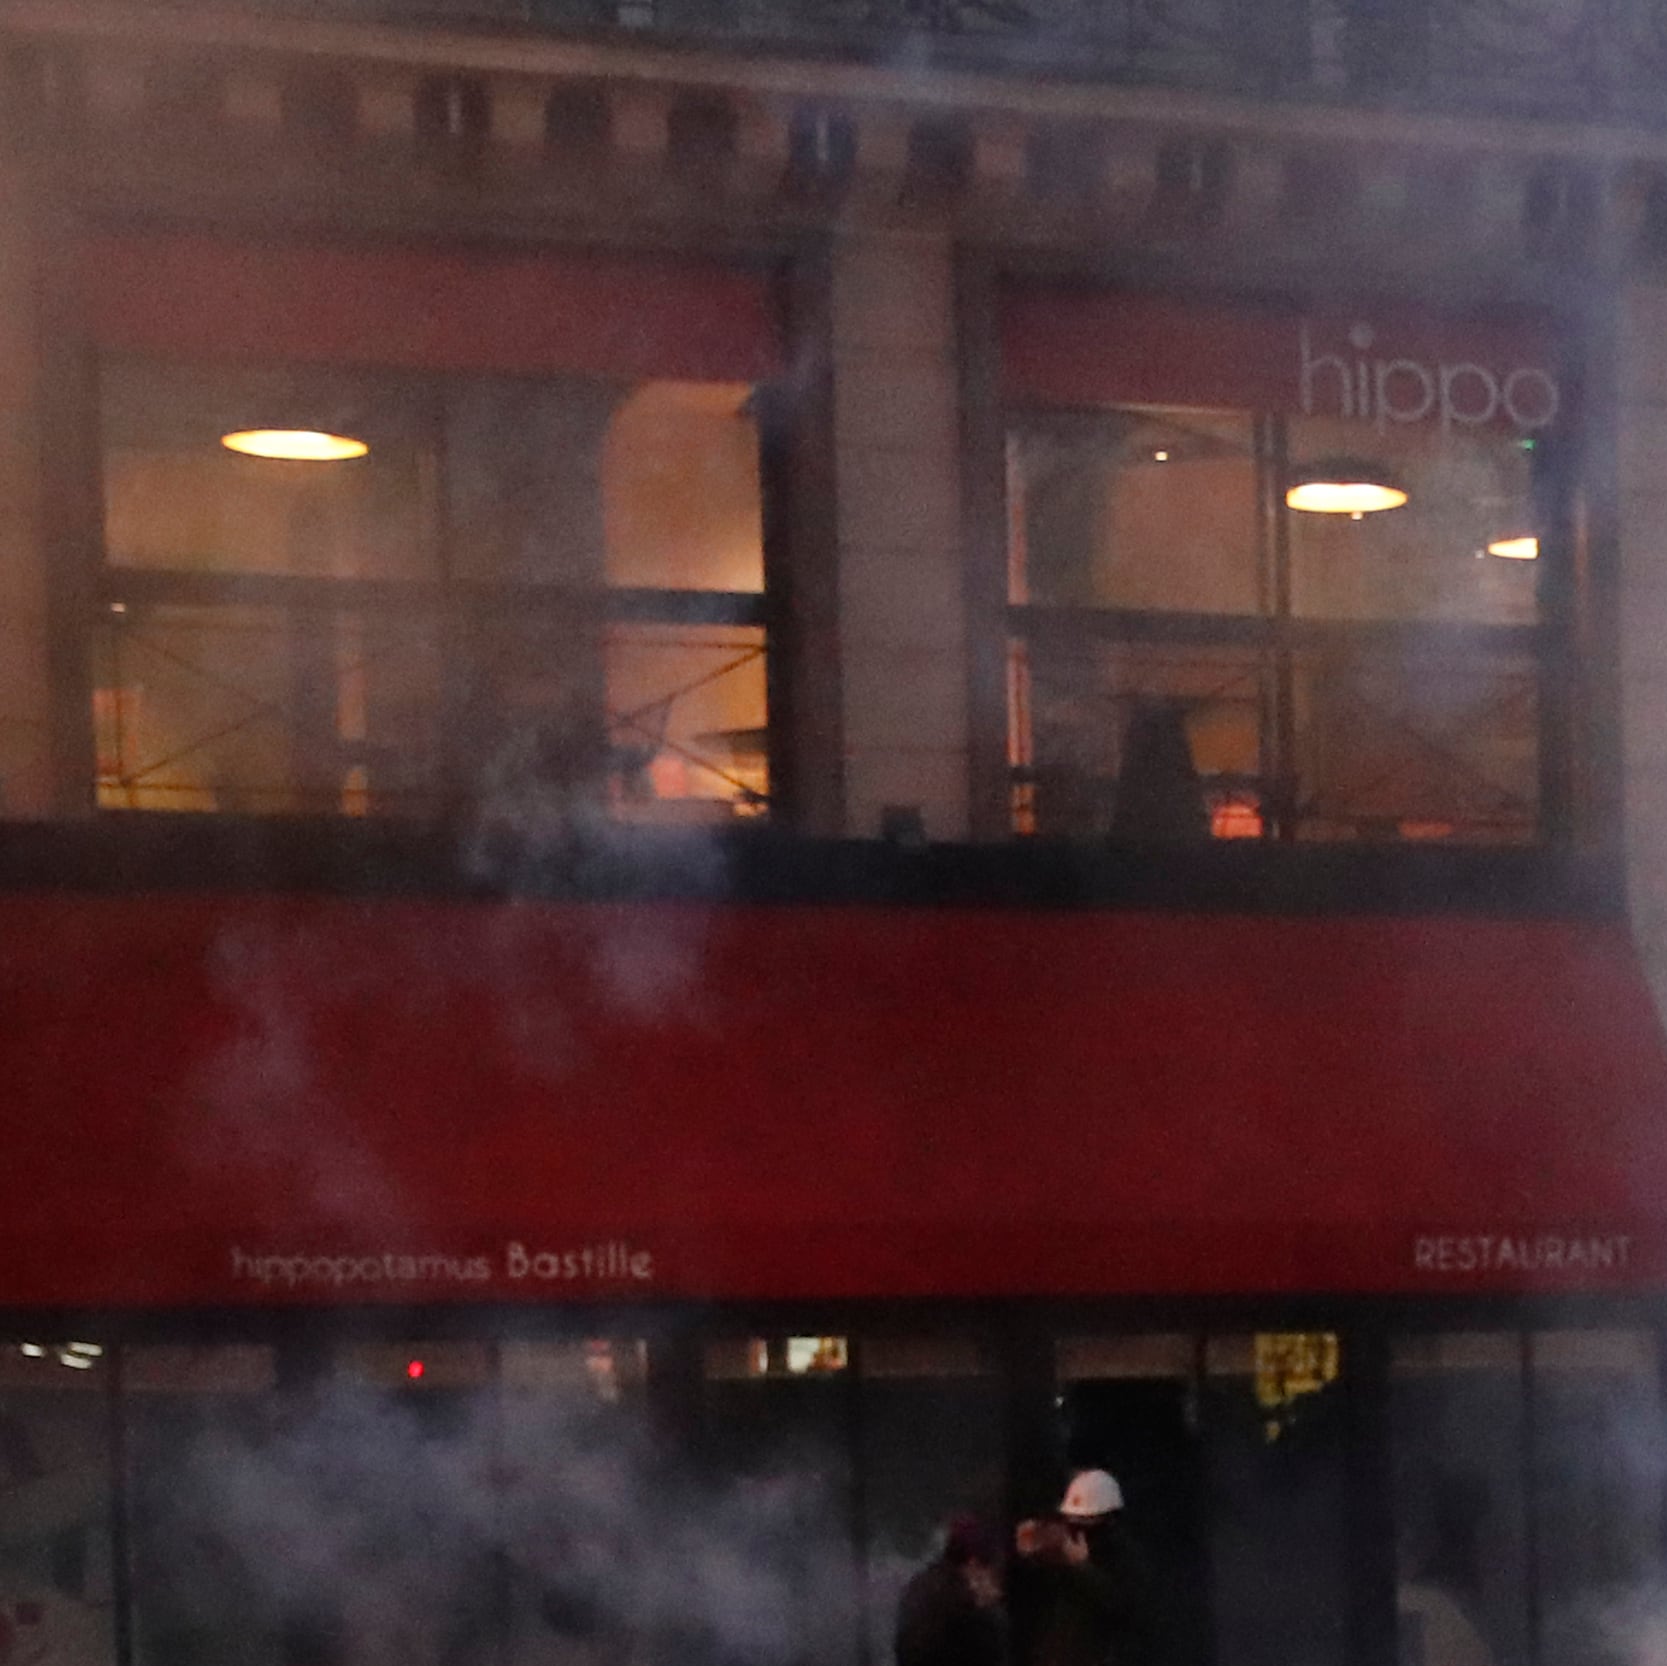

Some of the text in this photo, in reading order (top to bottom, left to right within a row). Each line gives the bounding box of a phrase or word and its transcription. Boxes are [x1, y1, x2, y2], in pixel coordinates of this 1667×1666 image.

[1300, 318, 1559, 438] hippo
[230, 1241, 653, 1285] hippopotamus Bastille
[1415, 1235, 1631, 1271] RESTAURANT
